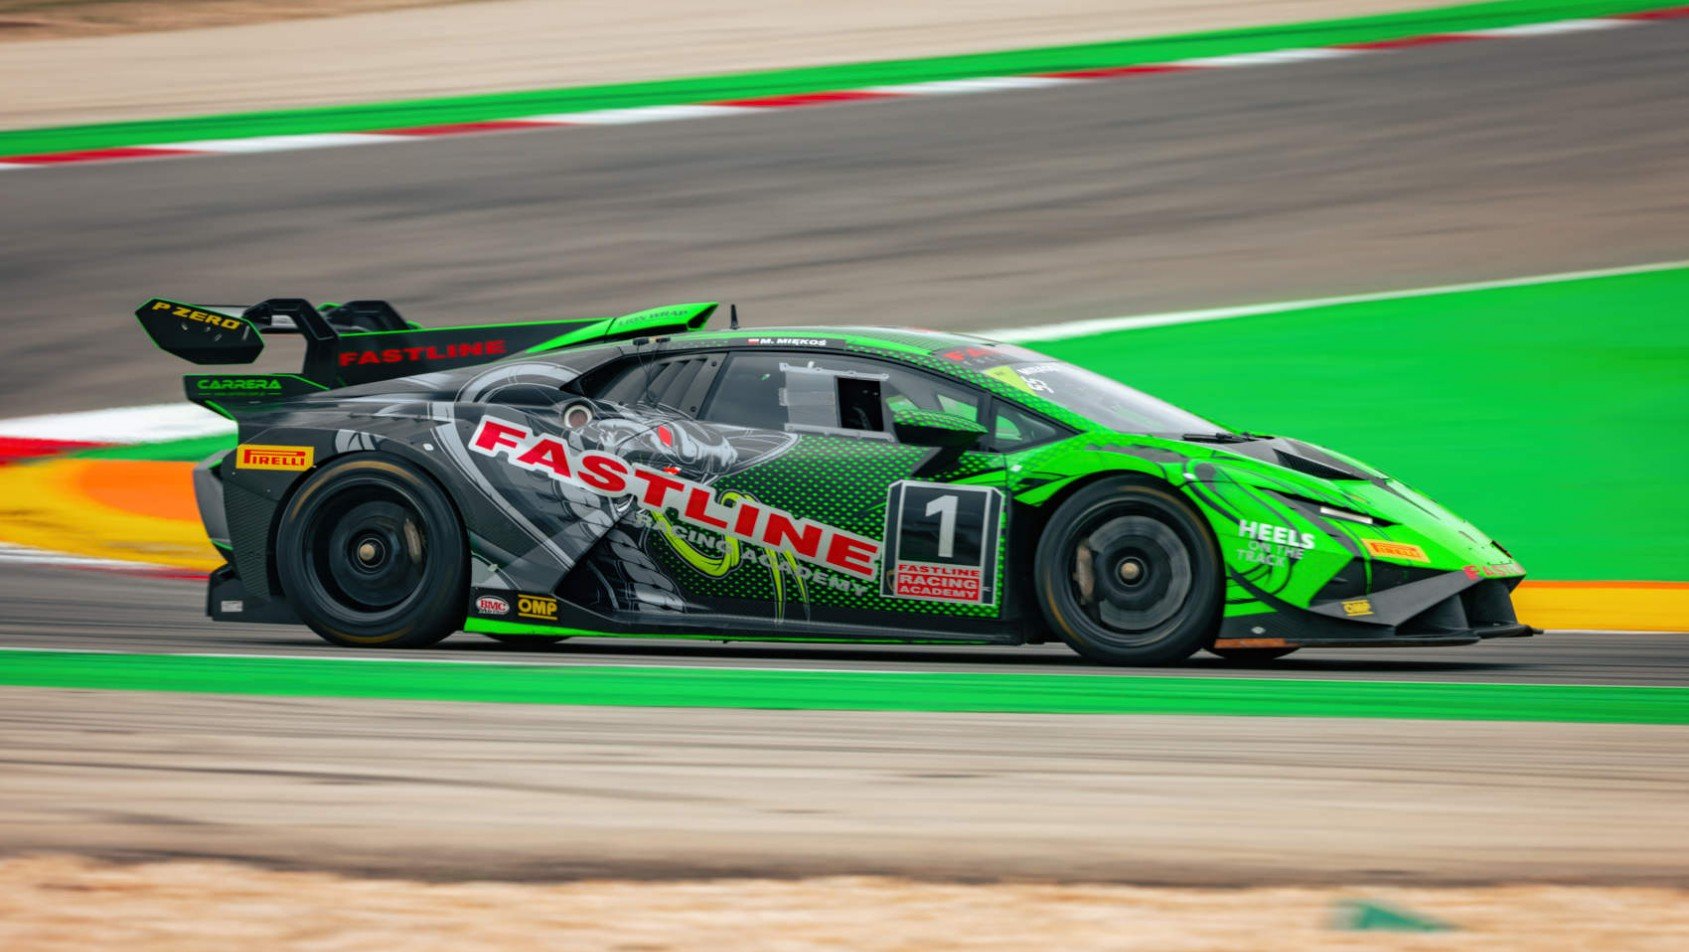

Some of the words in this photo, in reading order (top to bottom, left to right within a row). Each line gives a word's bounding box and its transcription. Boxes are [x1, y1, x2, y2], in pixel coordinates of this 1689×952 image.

[152, 301, 171, 311] P
[172, 306, 241, 330] ZERO
[338, 340, 507, 367] FASTLINE
[196, 378, 283, 390] CARRERA
[243, 449, 306, 467] PIRELLI
[474, 419, 880, 577] FASTLINE
[636, 512, 733, 552] RACING
[925, 494, 959, 559] 1
[1238, 519, 1316, 549] HEELS
[1237, 548, 1285, 568] TRACK
[1248, 541, 1271, 554] ON
[1276, 545, 1304, 560] THE
[741, 549, 869, 597] ACADEMY
[898, 563, 980, 578] FASTLINE
[899, 574, 977, 590] RACING
[899, 585, 977, 599] ACADEMY
[479, 599, 507, 612] BMC
[518, 598, 558, 615] OMP
